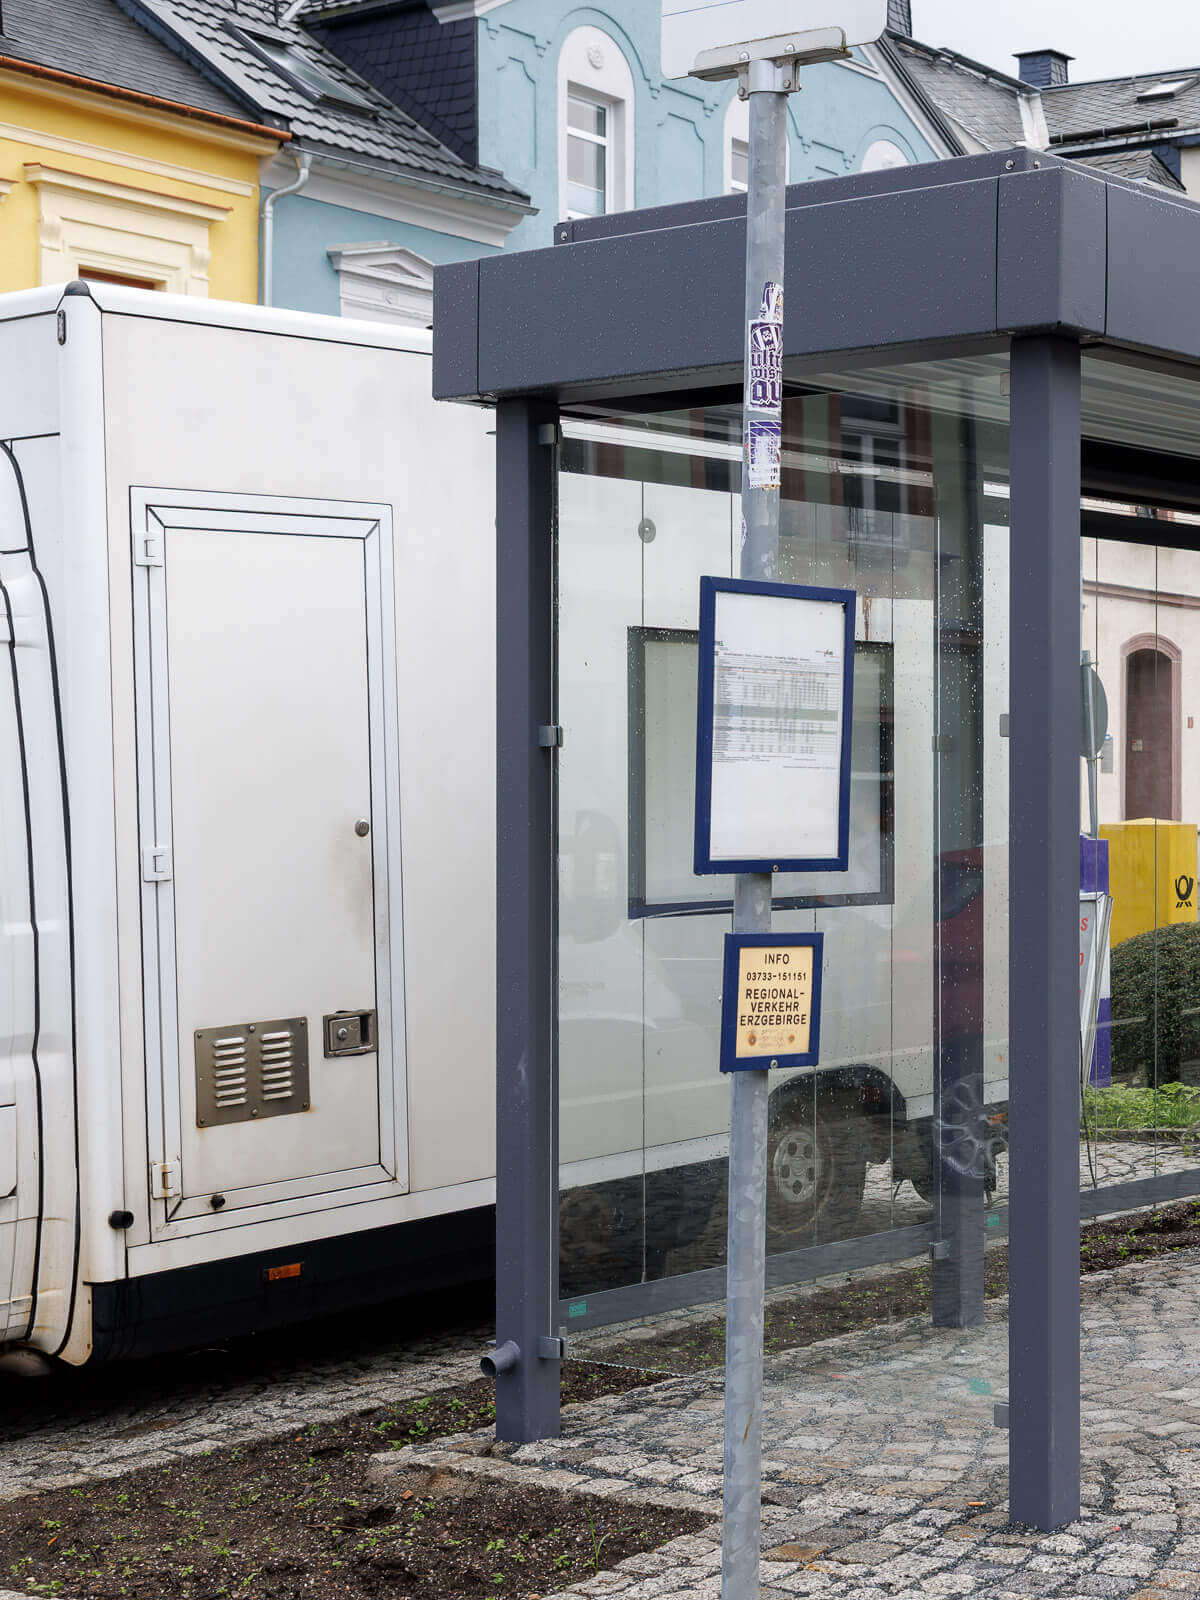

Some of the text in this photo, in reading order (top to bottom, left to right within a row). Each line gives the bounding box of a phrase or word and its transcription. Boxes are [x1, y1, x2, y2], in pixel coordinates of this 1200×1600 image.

[764, 953, 790, 965] INFO
[746, 972, 807, 981] 03733-151151
[745, 988, 805, 1000] REGIONAL-
[751, 1001, 800, 1013] VERKEHR
[740, 1013, 807, 1026] ERZGEBIRGE
